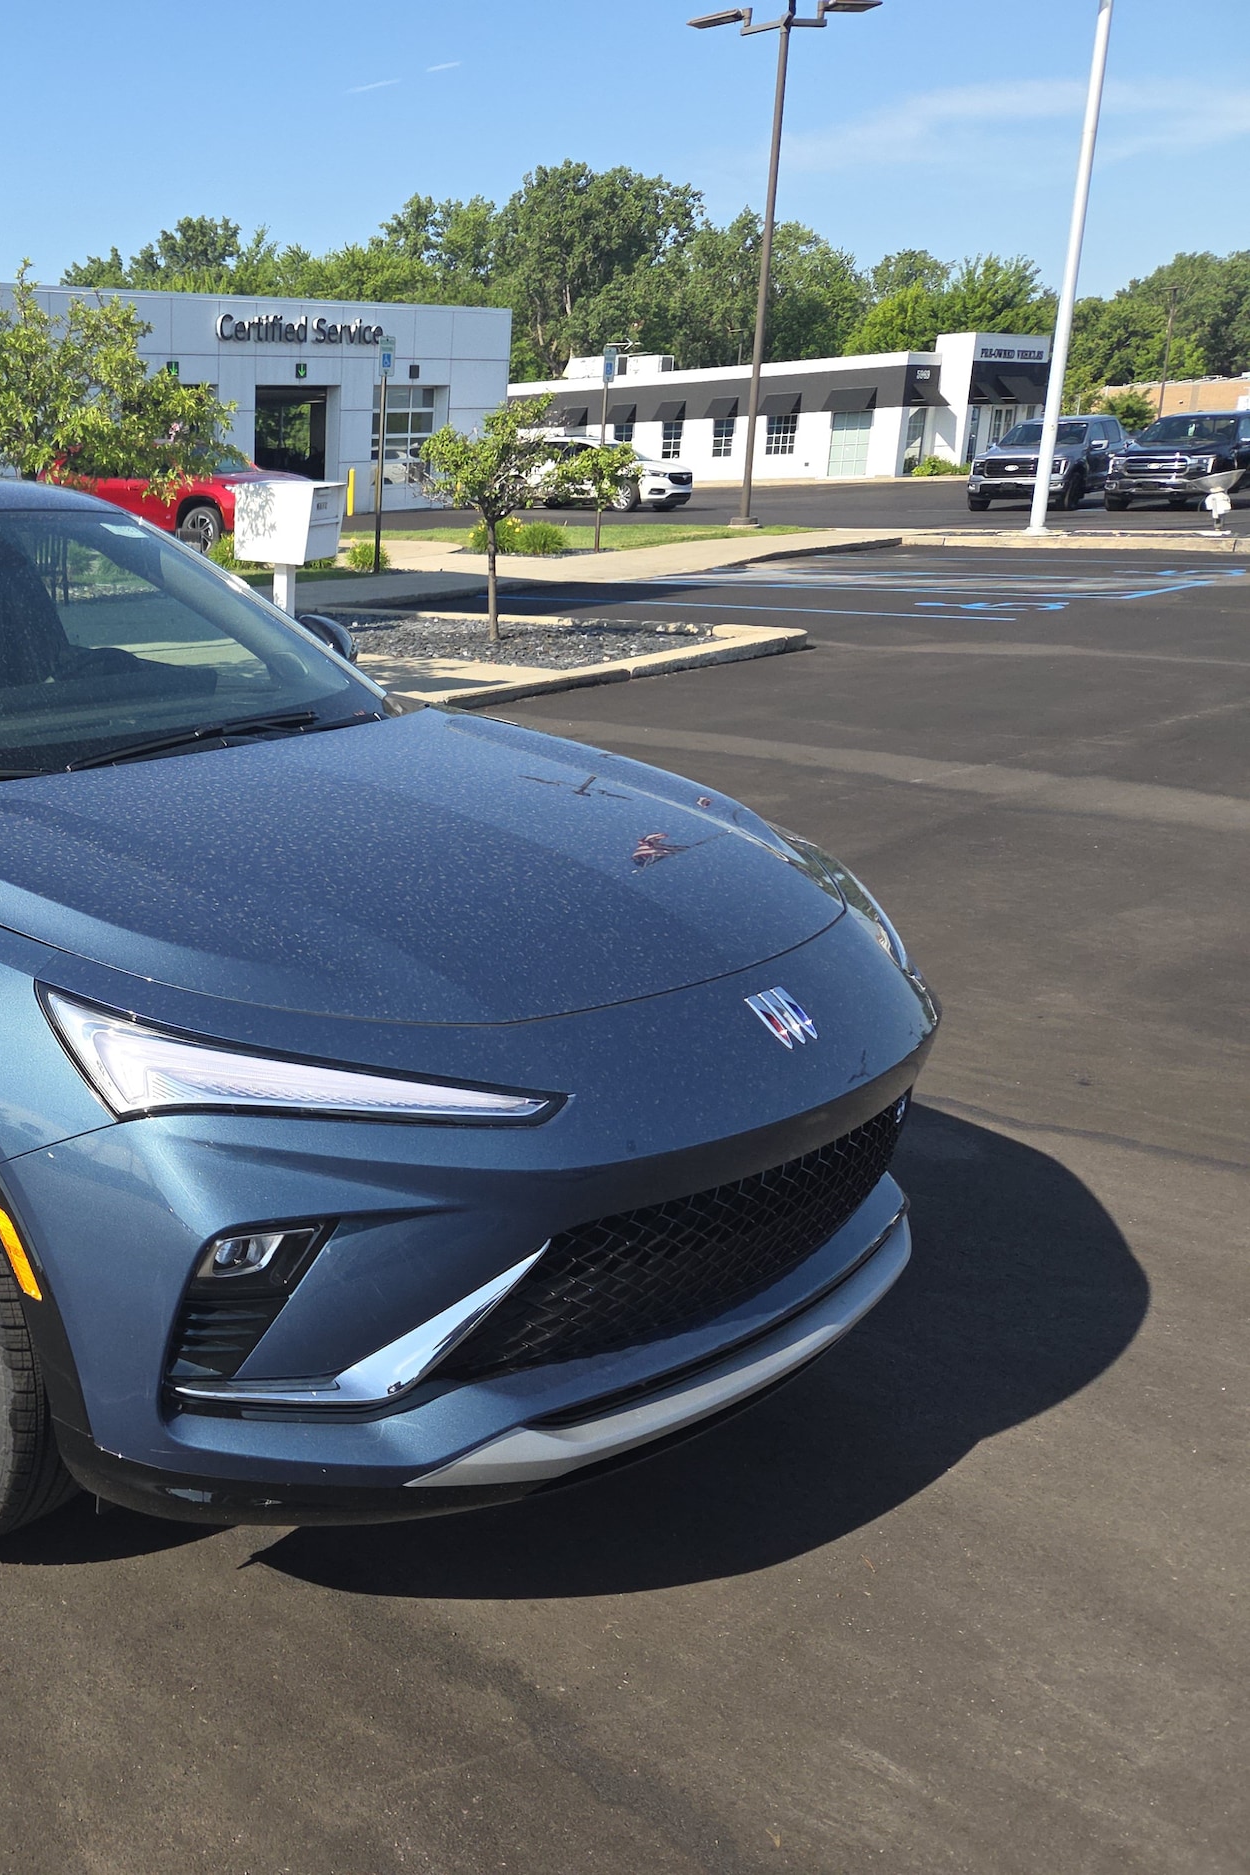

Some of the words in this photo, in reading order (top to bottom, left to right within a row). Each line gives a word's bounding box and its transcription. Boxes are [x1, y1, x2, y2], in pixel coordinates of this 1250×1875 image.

[216, 313, 308, 343] Certified
[313, 317, 383, 345] Service
[980, 348, 1015, 359] PRE-OWNED
[1017, 350, 1044, 361] VEHICLES
